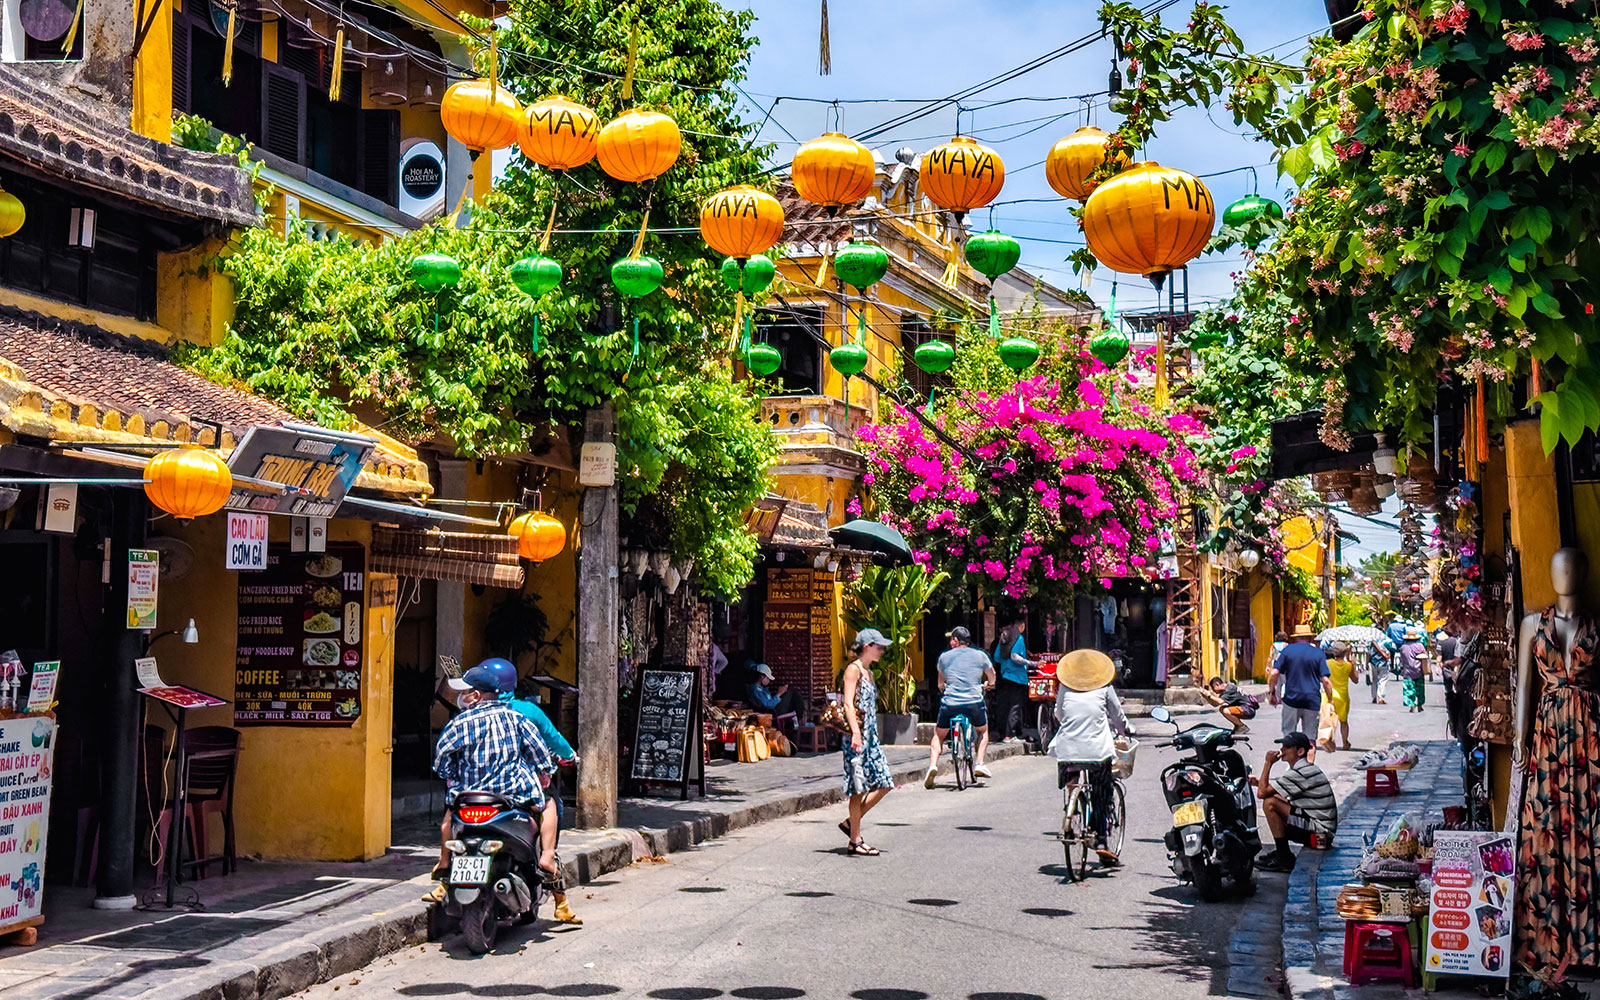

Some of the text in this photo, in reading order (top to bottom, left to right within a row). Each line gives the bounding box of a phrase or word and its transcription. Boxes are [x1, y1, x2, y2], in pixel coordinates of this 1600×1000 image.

[930, 148, 994, 183] MAYA
[404, 174, 439, 182] ROASTERY
[701, 195, 758, 219] MAYA
[231, 518, 248, 540] CAO
[132, 552, 148, 560] TEA
[232, 541, 262, 566] CƠM GÀ
[342, 572, 363, 591] TEA
[238, 585, 303, 595] YANGZHOU FRIED RICE
[238, 616, 283, 625] EGG FRIED RICE
[764, 620, 808, 630] はんこ
[1174, 625, 1184, 649] ATM
[255, 646, 278, 656] NOODLE
[278, 647, 294, 656] SOUP
[236, 669, 280, 685] COFFEE
[234, 711, 259, 720] BLACK
[265, 712, 284, 720] MILK
[0, 741, 20, 754] HAKE
[0, 754, 13, 772] RÁI
[0, 775, 17, 788] UICE
[11, 787, 30, 800] GREEN
[32, 785, 48, 797] BEAN
[21, 801, 42, 817] XANH
[0, 824, 14, 836] RUIT
[458, 858, 484, 869] 92-C1
[452, 870, 486, 881] 210.47
